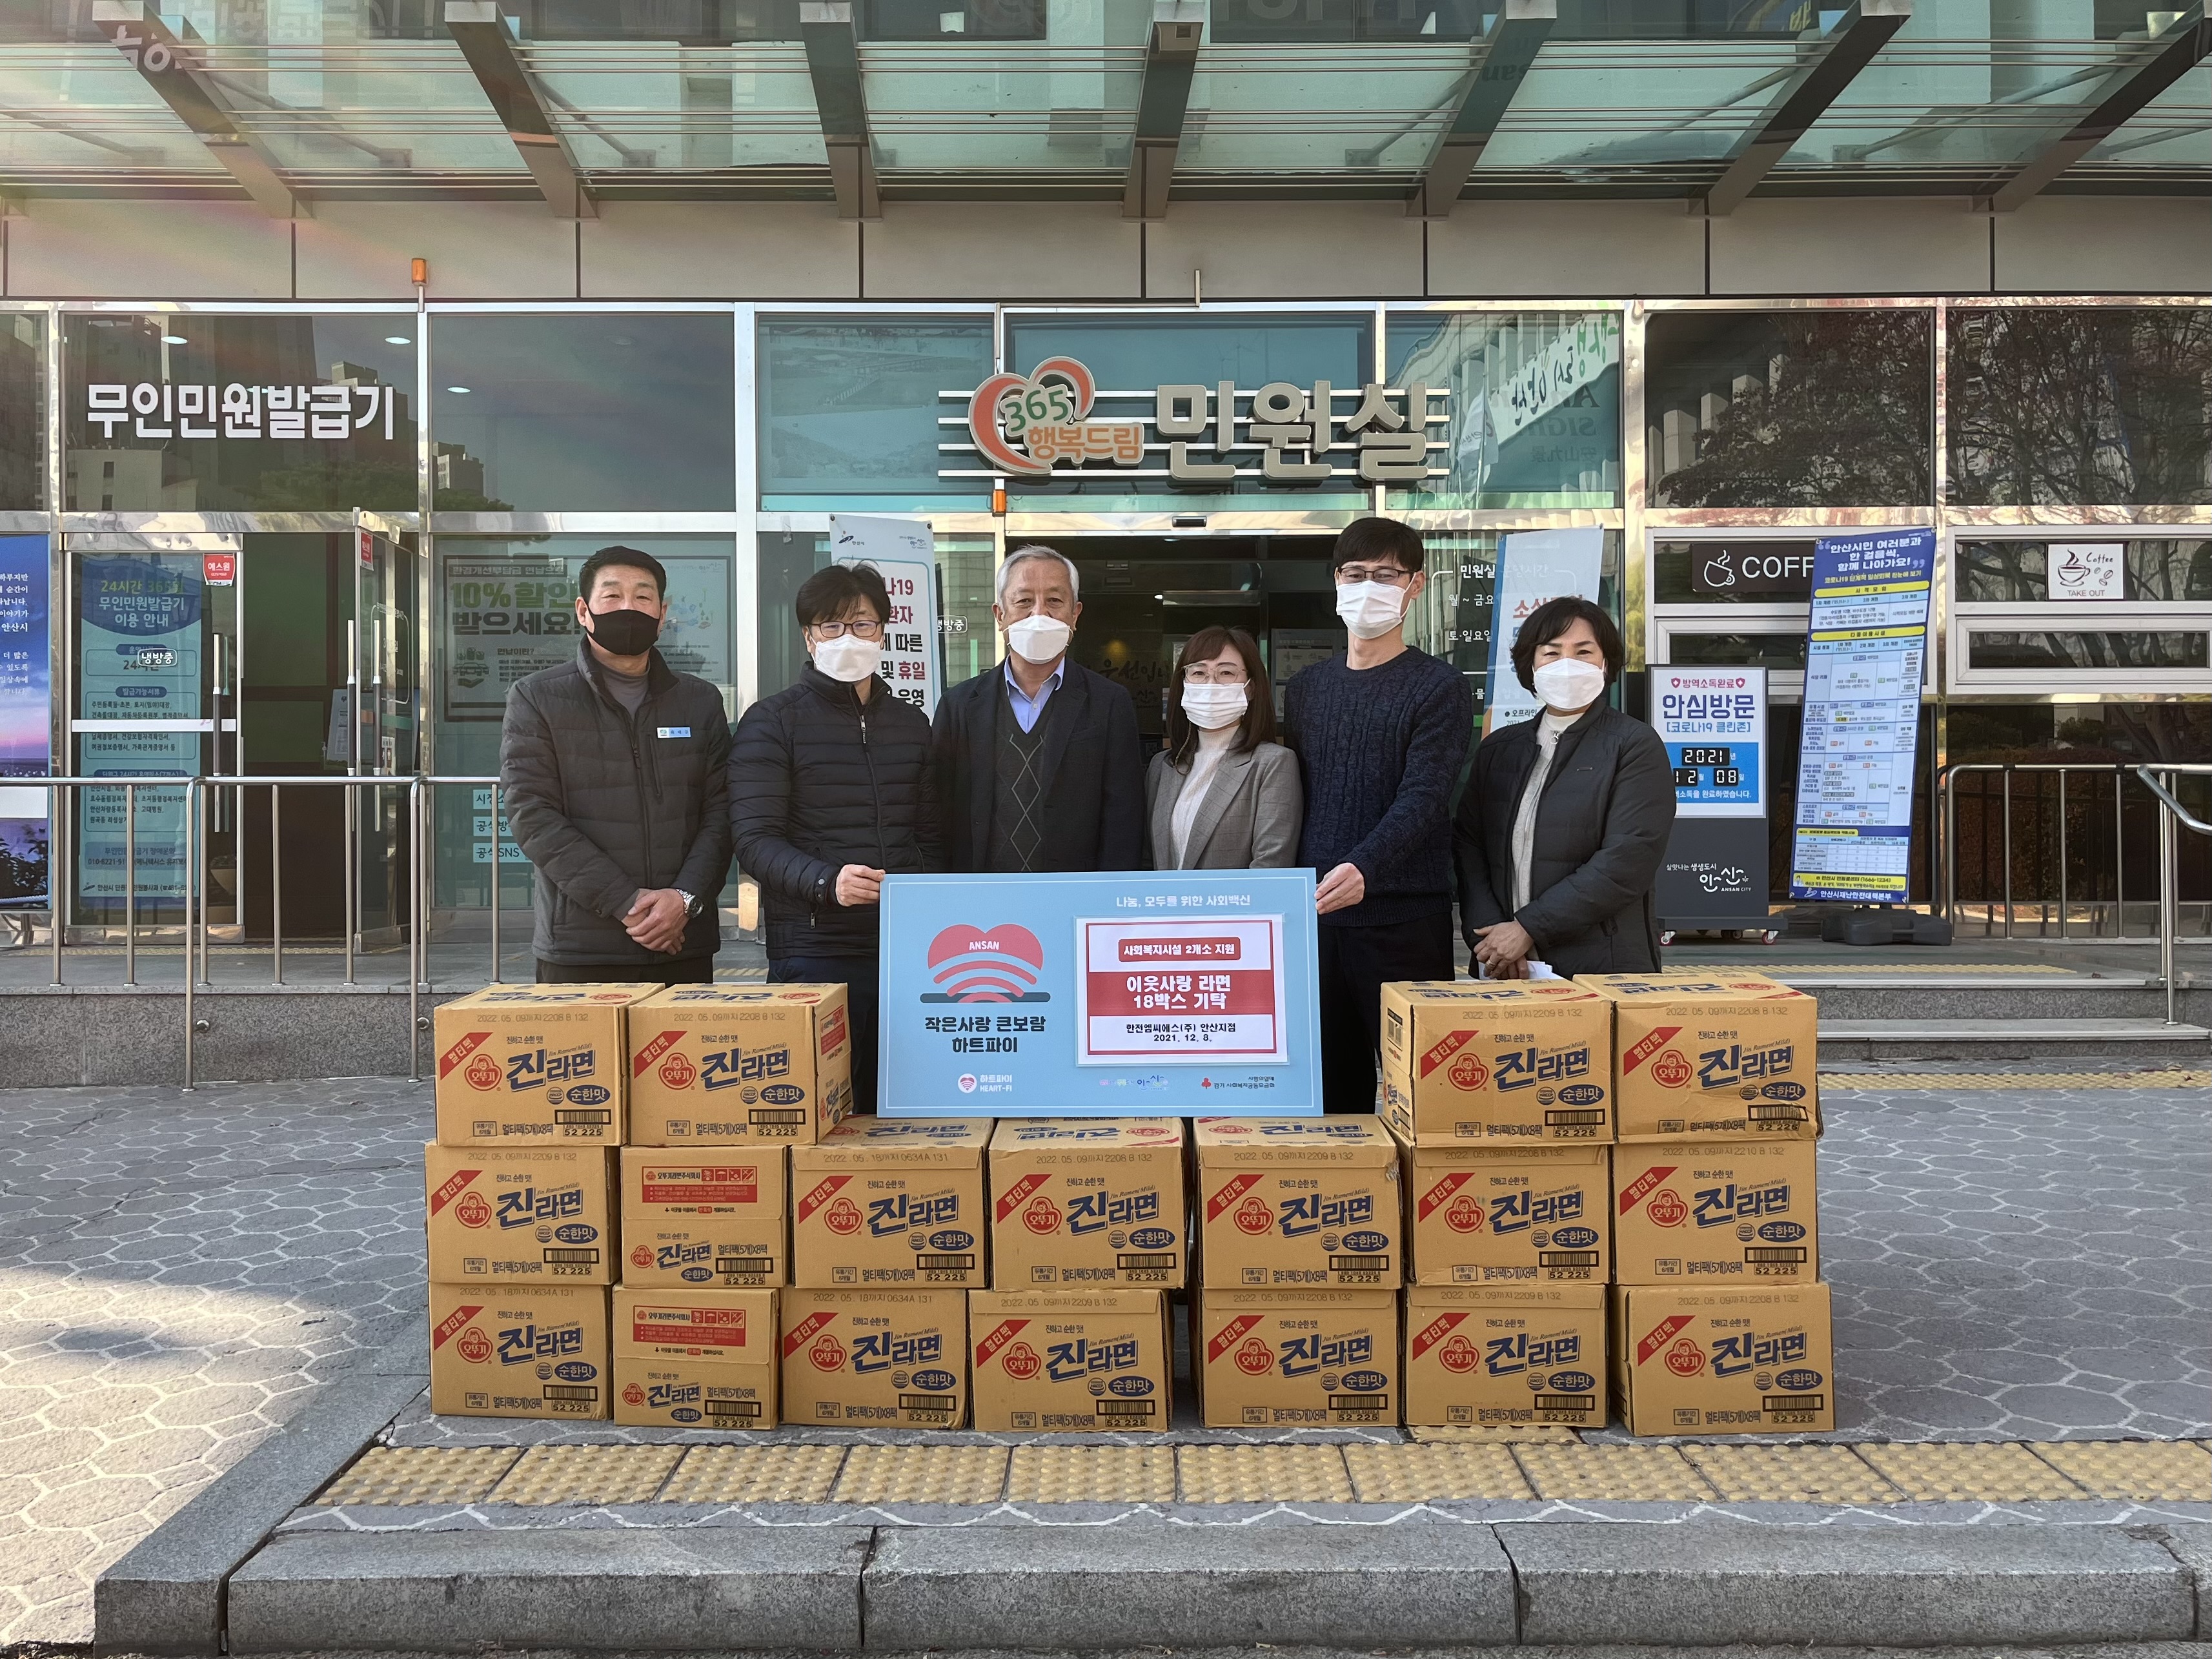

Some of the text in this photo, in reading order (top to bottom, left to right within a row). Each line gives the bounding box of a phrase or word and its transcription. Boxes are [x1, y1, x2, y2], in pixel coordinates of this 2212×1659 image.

[88, 382, 393, 440] 무인민원발급기
[1004, 388, 1068, 432] 365
[1157, 380, 1428, 481] 민원실
[1028, 423, 1141, 460] 행복드림
[1831, 537, 1922, 554] 안산시민 여러분과
[2086, 553, 2113, 563] Coffee
[208, 562, 230, 571] 에스원
[1461, 564, 1495, 578] 민원실
[1838, 562, 1859, 571] 함께
[101, 581, 142, 594] 24시간
[452, 582, 580, 608] 10% 할인
[99, 597, 184, 611] 무인민원발급기
[115, 613, 168, 627] 이용 안내
[1, 623, 28, 632] 안산시
[896, 634, 923, 652] 따른
[142, 653, 173, 664] 냉방중
[882, 661, 926, 680] 및 휴일
[1683, 679, 1734, 688] 방역소독완료
[1663, 695, 1755, 718] 안심방문
[1685, 750, 1722, 763] 2021
[1716, 770, 1736, 783] 08
[1117, 895, 1250, 908] 나눔, 모두를 위한 사회백신
[969, 941, 999, 950] ANSAN
[1124, 944, 1235, 956] 사회복지시설 2개소 지원
[1127, 975, 1231, 992] 이웃사랑 라면
[1134, 993, 1226, 1010] 18박스 기탁
[925, 1016, 1046, 1032] 작은사랑 큰보람
[1126, 1023, 1235, 1033] 한전엠씨에스(주) 안산지점
[448, 1038, 475, 1064] 멀티팩
[952, 1037, 1017, 1052] 하트파이
[506, 1048, 595, 1092] 진라면
[700, 1048, 791, 1092] 진라면
[1494, 1047, 1589, 1092] 진라면
[1698, 1044, 1794, 1090] 진라면
[472, 1072, 495, 1082] 오뚜기
[980, 1074, 1012, 1083] 하트파이
[1455, 1072, 1481, 1082] 오뚜기
[570, 1089, 606, 1101] 순한맛
[764, 1088, 800, 1101] 순한맛
[1766, 1084, 1801, 1098] 순한맛
[1215, 1180, 1245, 1207] 멀티팩
[496, 1188, 583, 1230] 진라면
[1066, 1190, 1159, 1236] 진라면
[1489, 1190, 1583, 1236] 진라면
[1692, 1184, 1790, 1229] 진라면
[462, 1209, 484, 1219] 오뚜기
[868, 1194, 959, 1238] 진라면
[1030, 1215, 1054, 1225] 오뚜기
[1278, 1193, 1374, 1237] 진라면
[1452, 1214, 1477, 1223] 오뚜기
[558, 1228, 594, 1240] 순한맛
[1133, 1232, 1170, 1245] 순한맛
[1556, 1230, 1594, 1243] 순한맛
[1762, 1226, 1801, 1238] 순한맛
[933, 1234, 969, 1247] 순한맛
[851, 1331, 942, 1374] 진라면
[1279, 1334, 1373, 1378] 진라면
[1485, 1333, 1581, 1377] 진라면
[1046, 1338, 1138, 1383] 진라면
[1672, 1357, 1698, 1367] 오뚜기
[915, 1374, 951, 1387] 순한맛
[1345, 1374, 1382, 1387] 순한맛
[1552, 1375, 1590, 1387] 순한맛
[647, 1384, 701, 1409] 진라면
[674, 1410, 699, 1420] 순한맛
